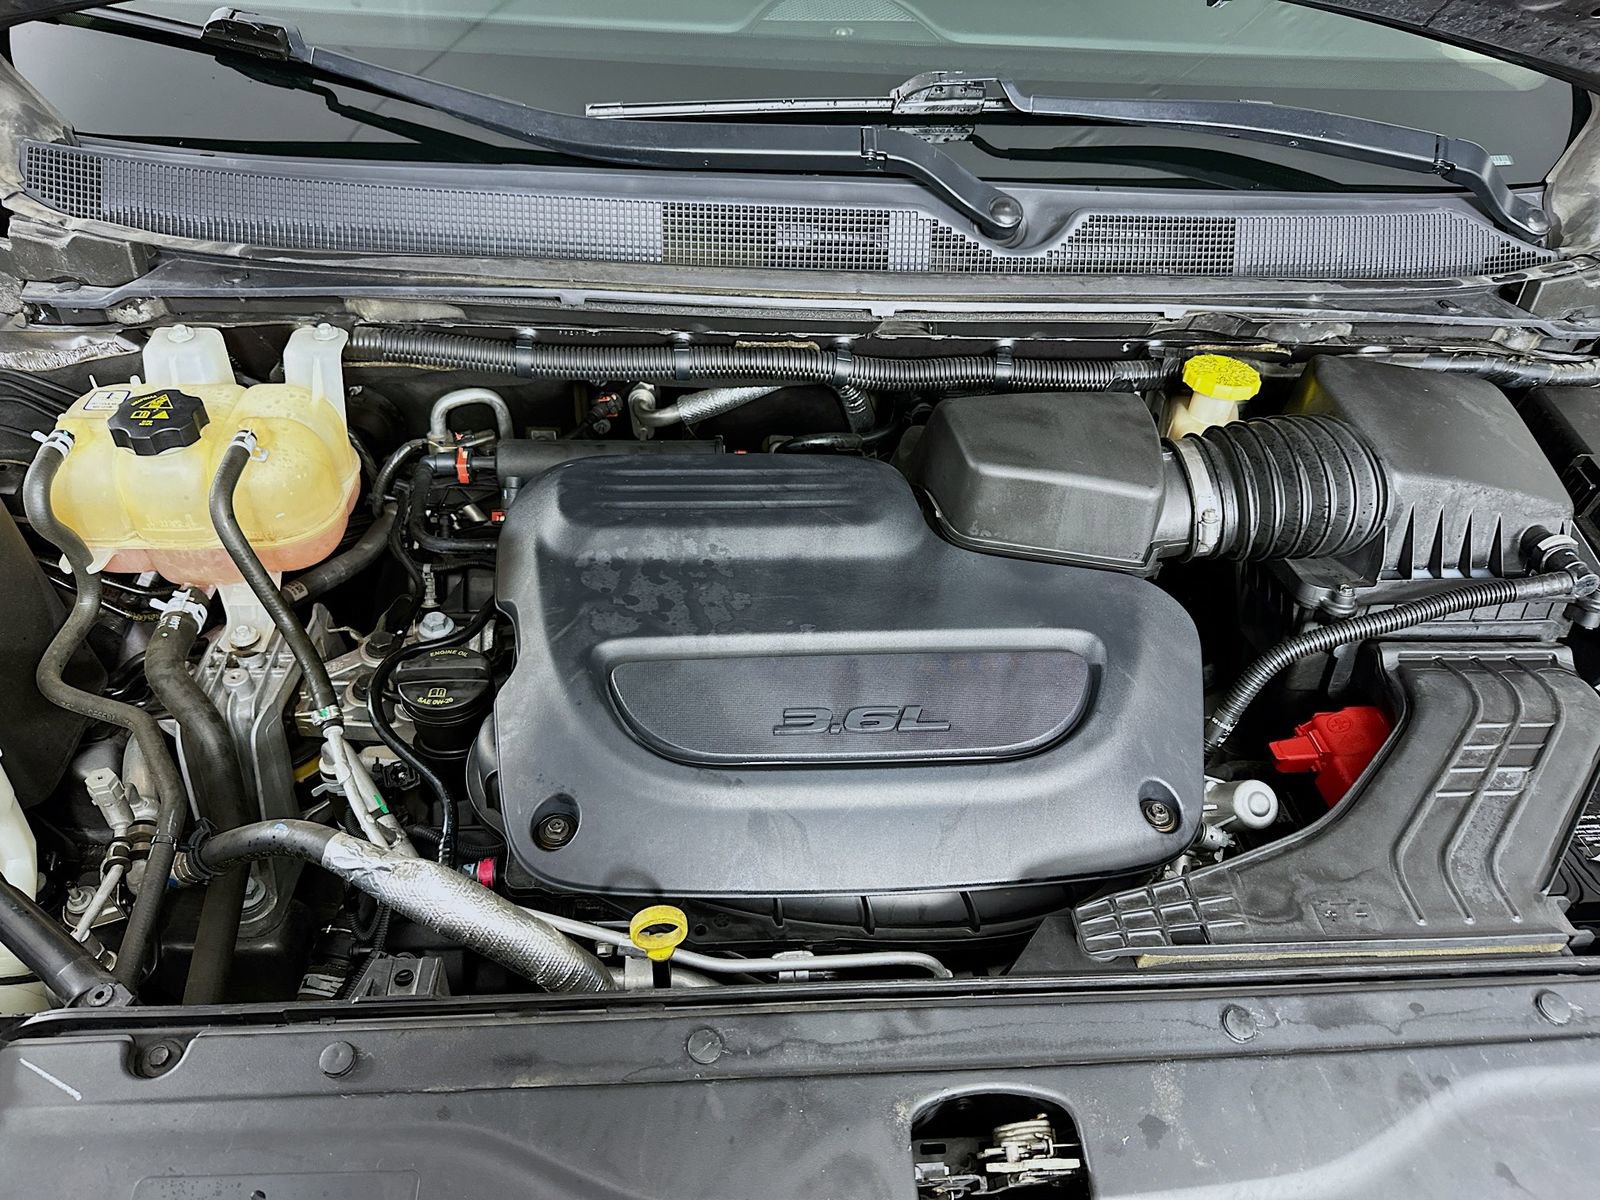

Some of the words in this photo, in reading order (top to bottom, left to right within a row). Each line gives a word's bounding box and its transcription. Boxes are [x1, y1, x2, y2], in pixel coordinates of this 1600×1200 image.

[430, 649, 457, 657] ENGINE
[458, 650, 469, 658] OIL
[416, 696, 431, 705] SAE
[432, 697, 454, 705] 0W-20
[773, 704, 952, 736] 3.6L
